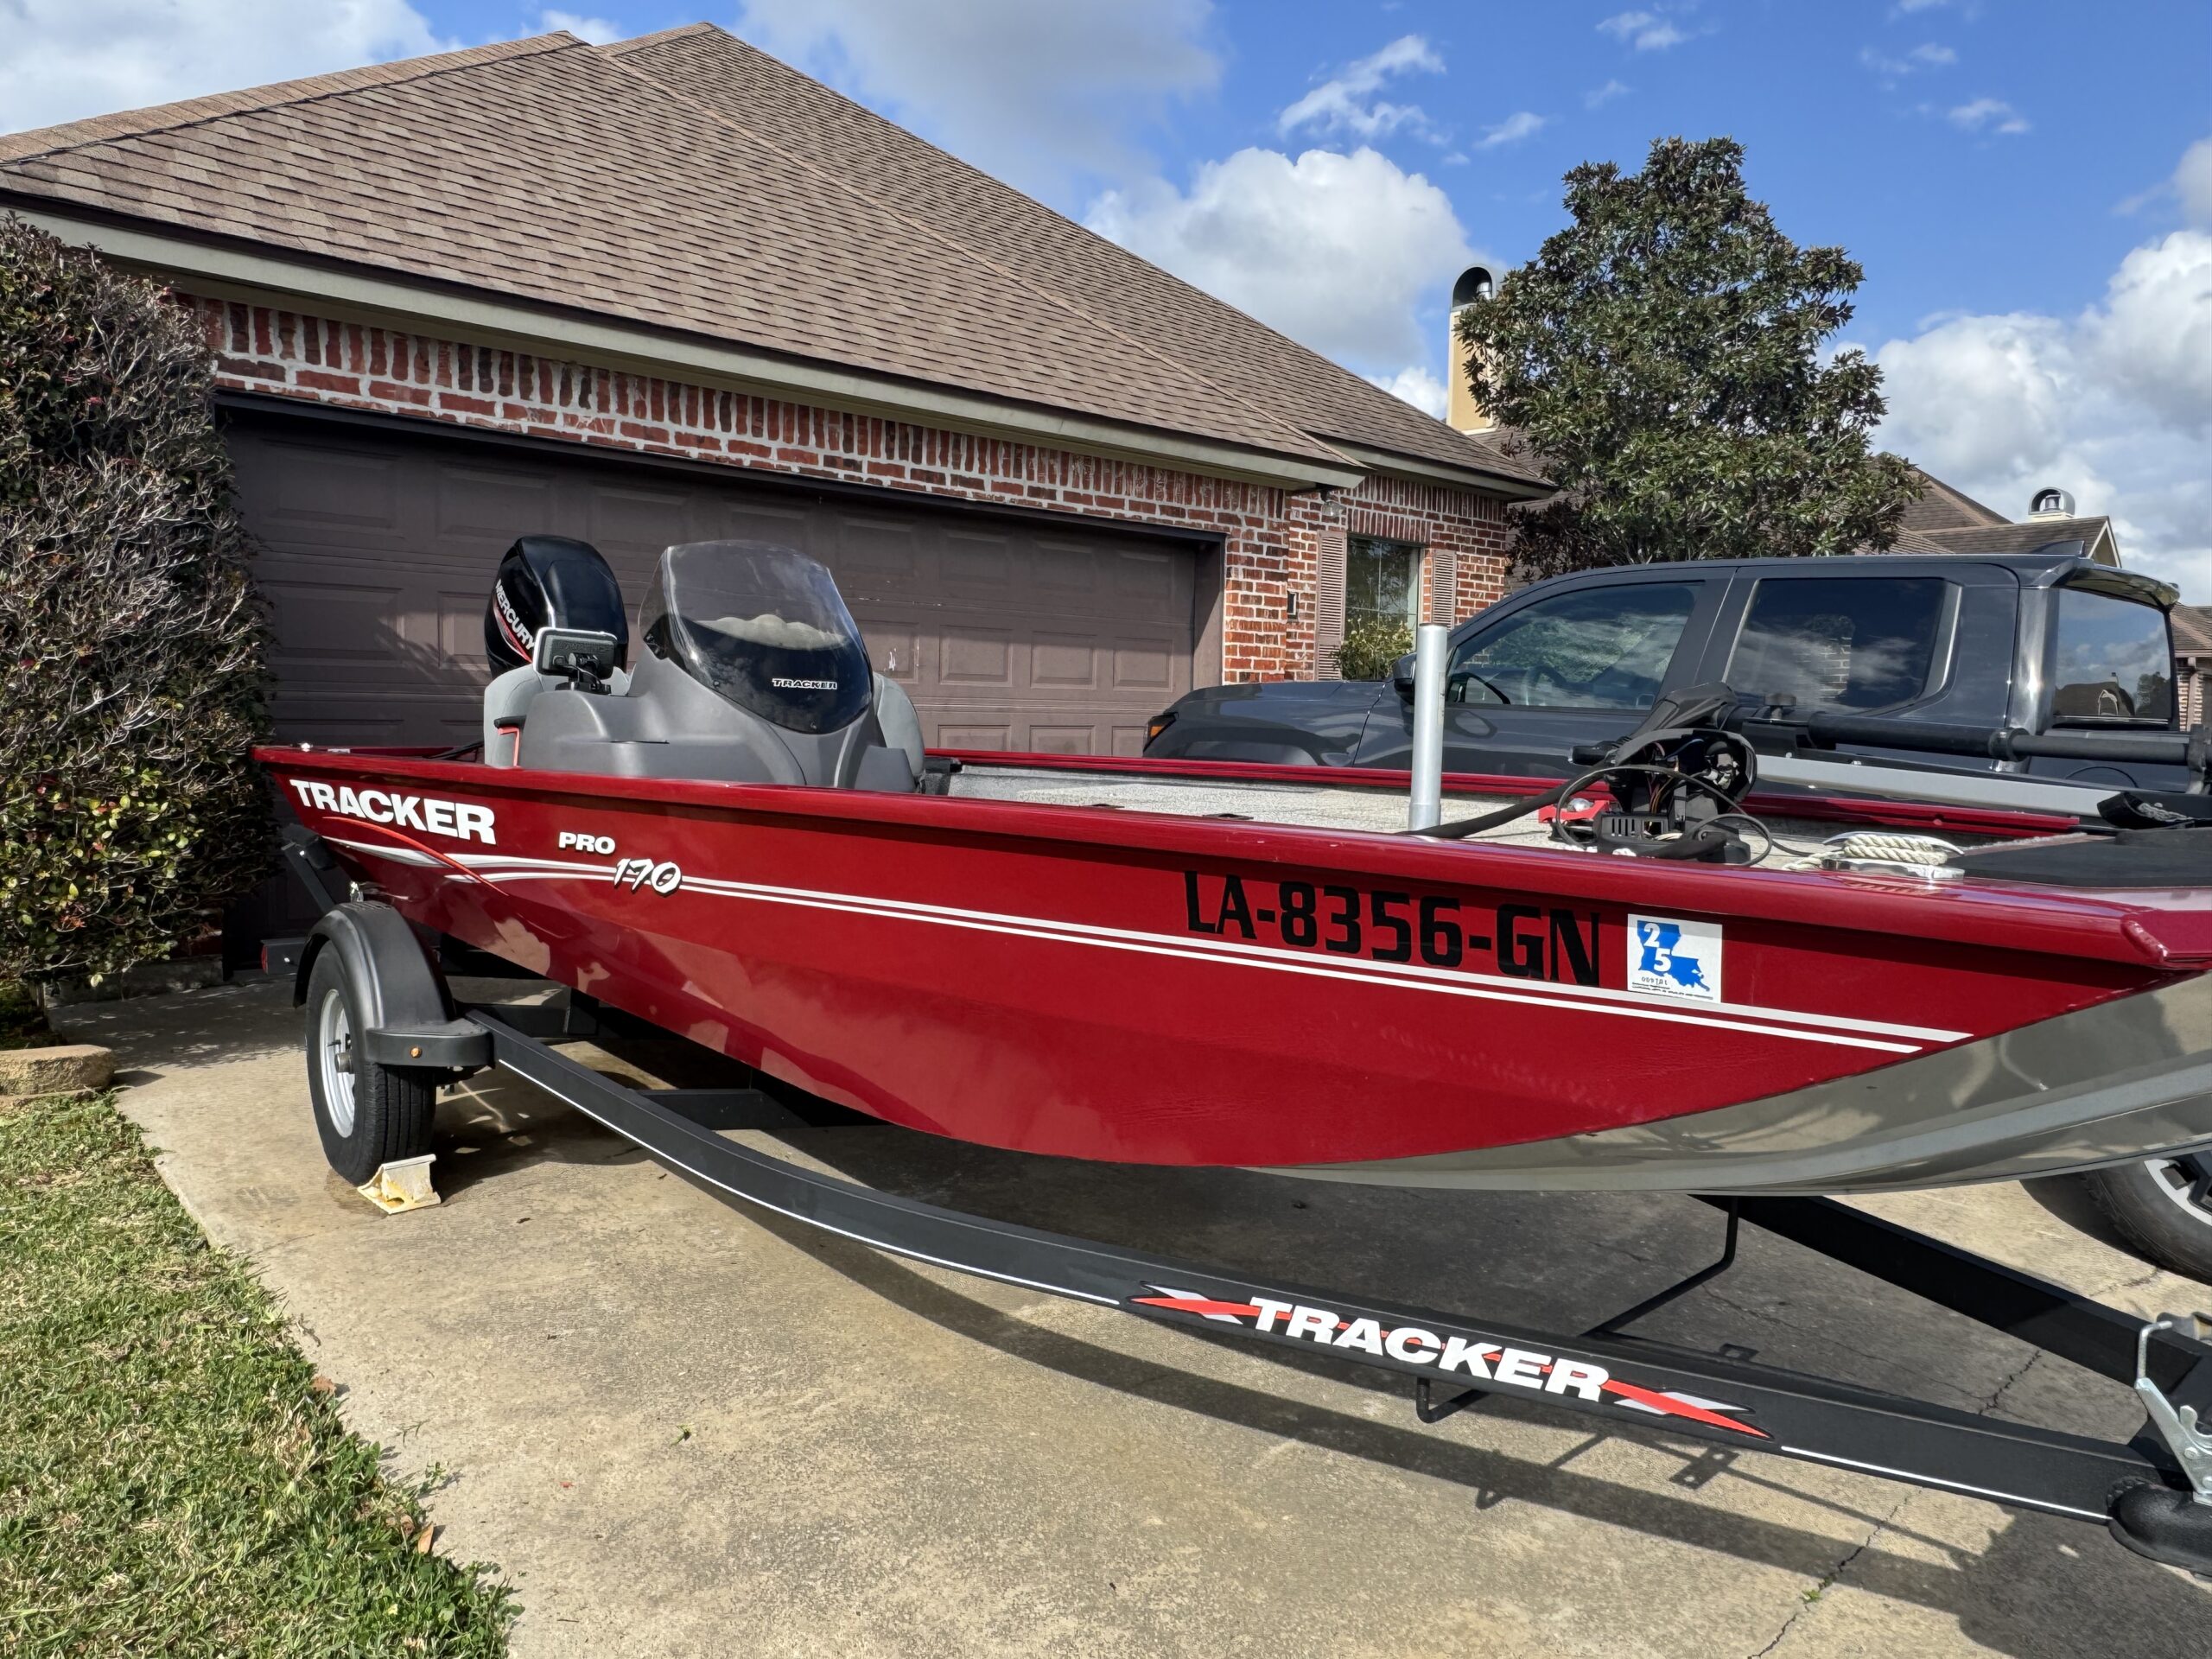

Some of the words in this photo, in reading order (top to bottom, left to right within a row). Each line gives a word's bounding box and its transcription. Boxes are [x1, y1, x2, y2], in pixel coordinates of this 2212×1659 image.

[495, 578, 536, 650] MERCURY
[772, 678, 838, 690] TRACKER
[289, 779, 497, 845] TRACKER
[558, 831, 616, 855] PRO
[613, 857, 683, 897] 170
[1184, 870, 1600, 988] LA-8356-GN
[1643, 922, 1661, 948] 2
[1653, 947, 1672, 972] 5
[1249, 1296, 1610, 1402] TRACKER
